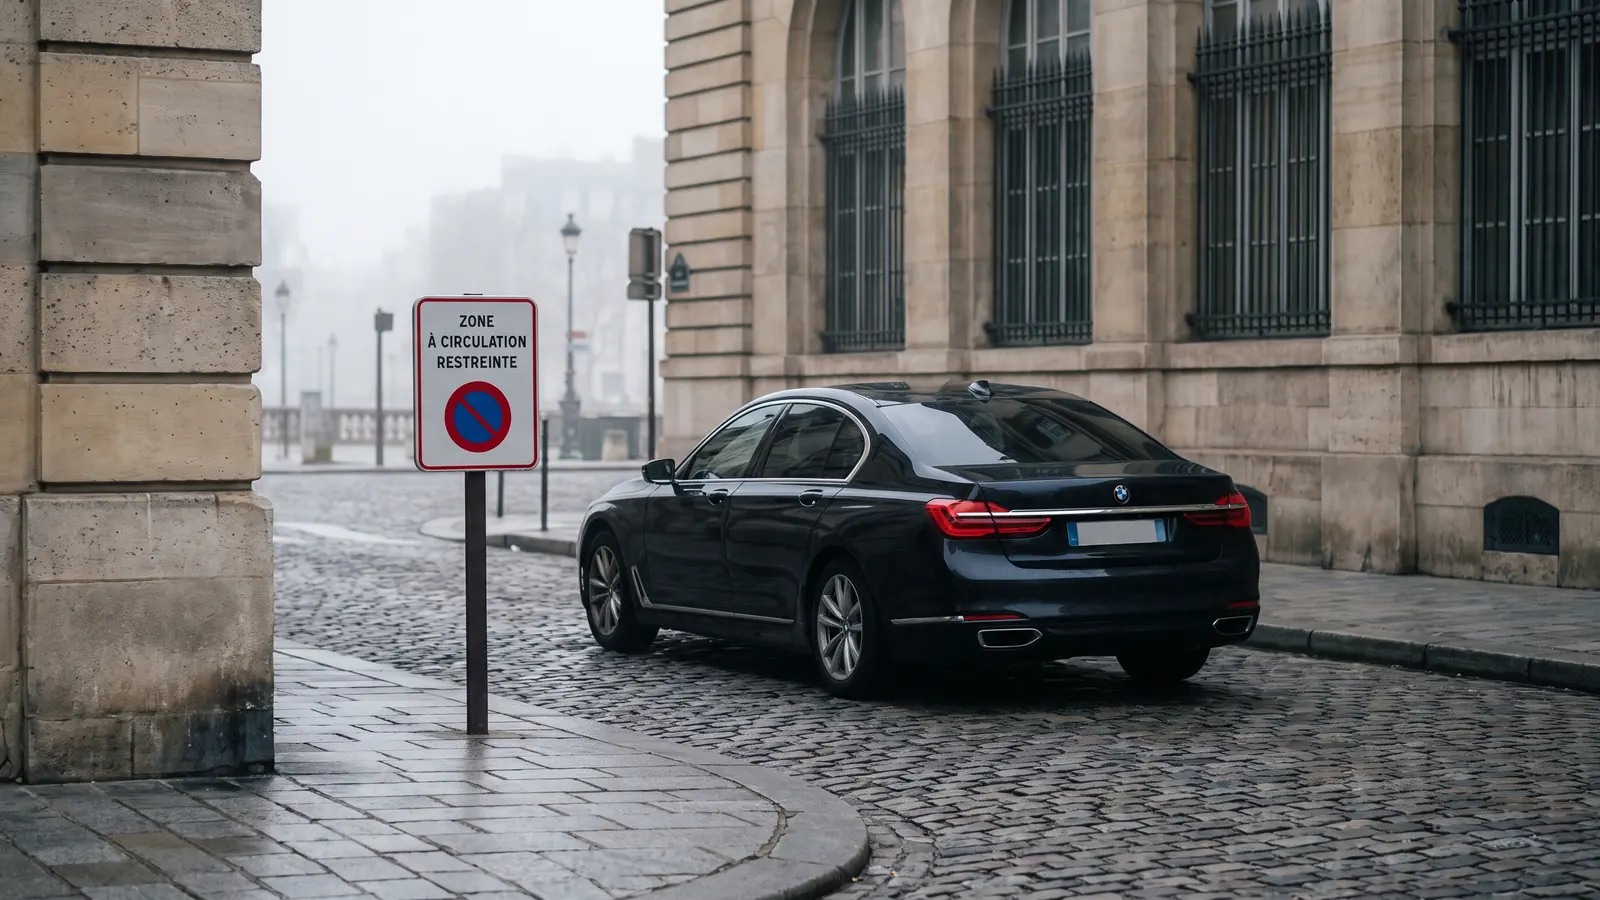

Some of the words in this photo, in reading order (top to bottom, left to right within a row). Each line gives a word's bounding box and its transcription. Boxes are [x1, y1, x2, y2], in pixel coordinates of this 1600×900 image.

[459, 314, 495, 328] ZONE
[427, 332, 437, 349] À
[440, 335, 527, 348] CIRCULATION
[436, 355, 518, 369] RESTREINTE
